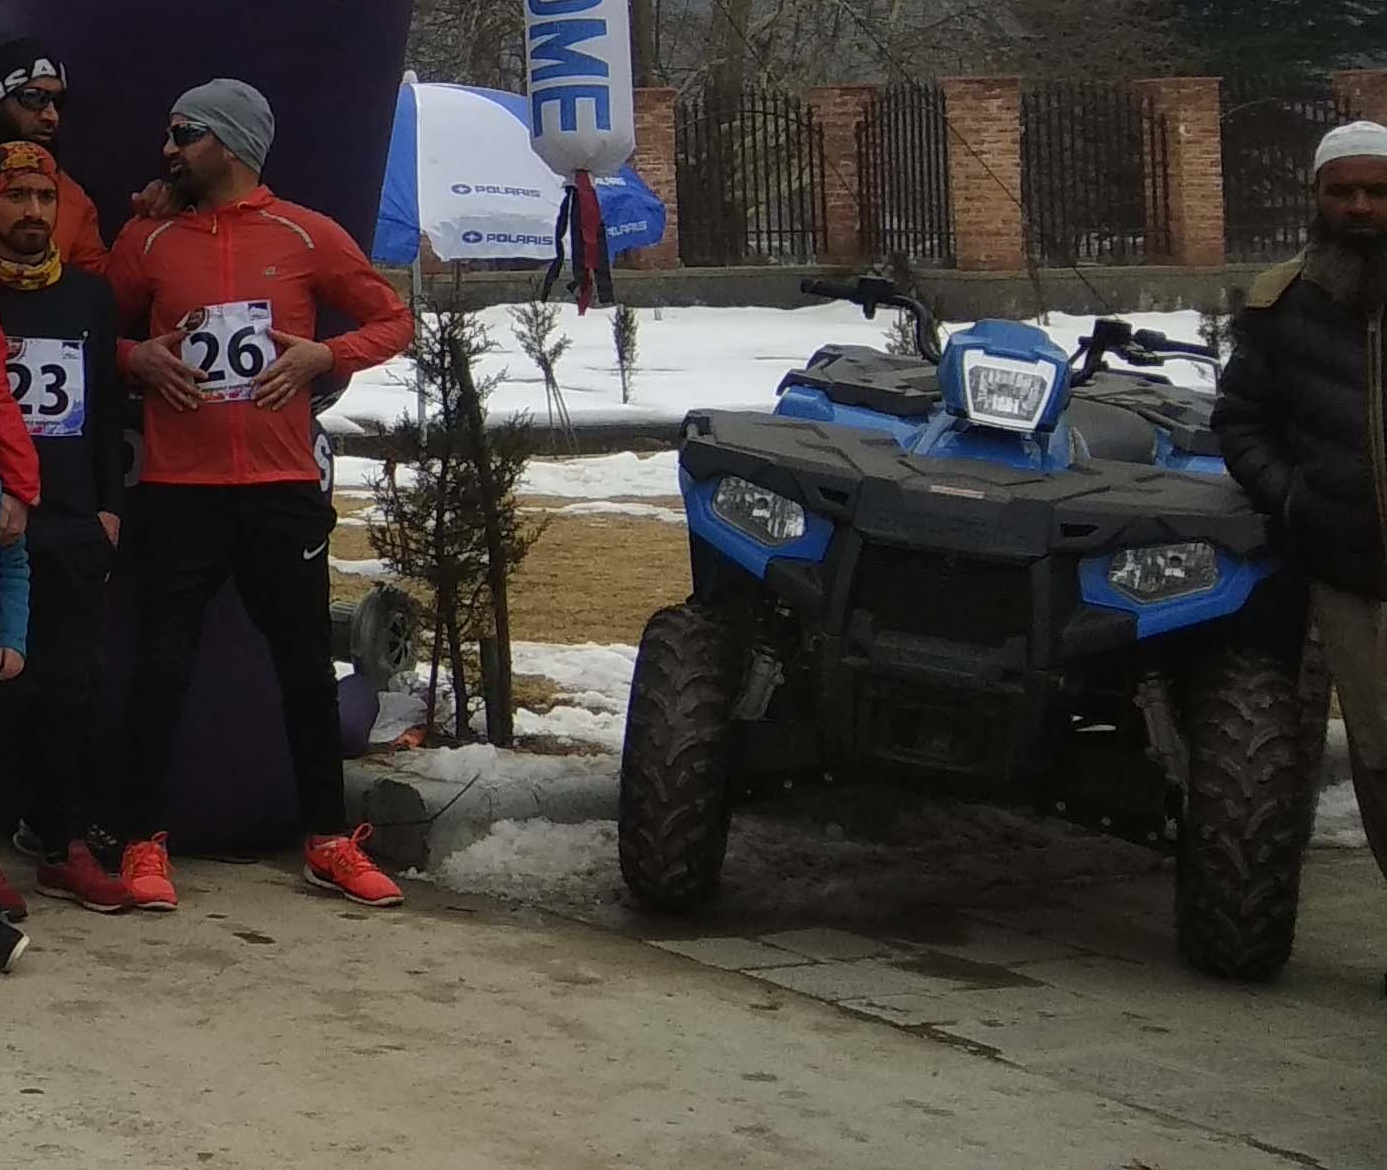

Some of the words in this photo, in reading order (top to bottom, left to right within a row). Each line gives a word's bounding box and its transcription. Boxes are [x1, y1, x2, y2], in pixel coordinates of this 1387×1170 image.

[474, 184, 541, 198] POLARIS
[485, 233, 554, 246] POLARIS
[189, 325, 264, 384] 26
[5, 362, 69, 416] 23
